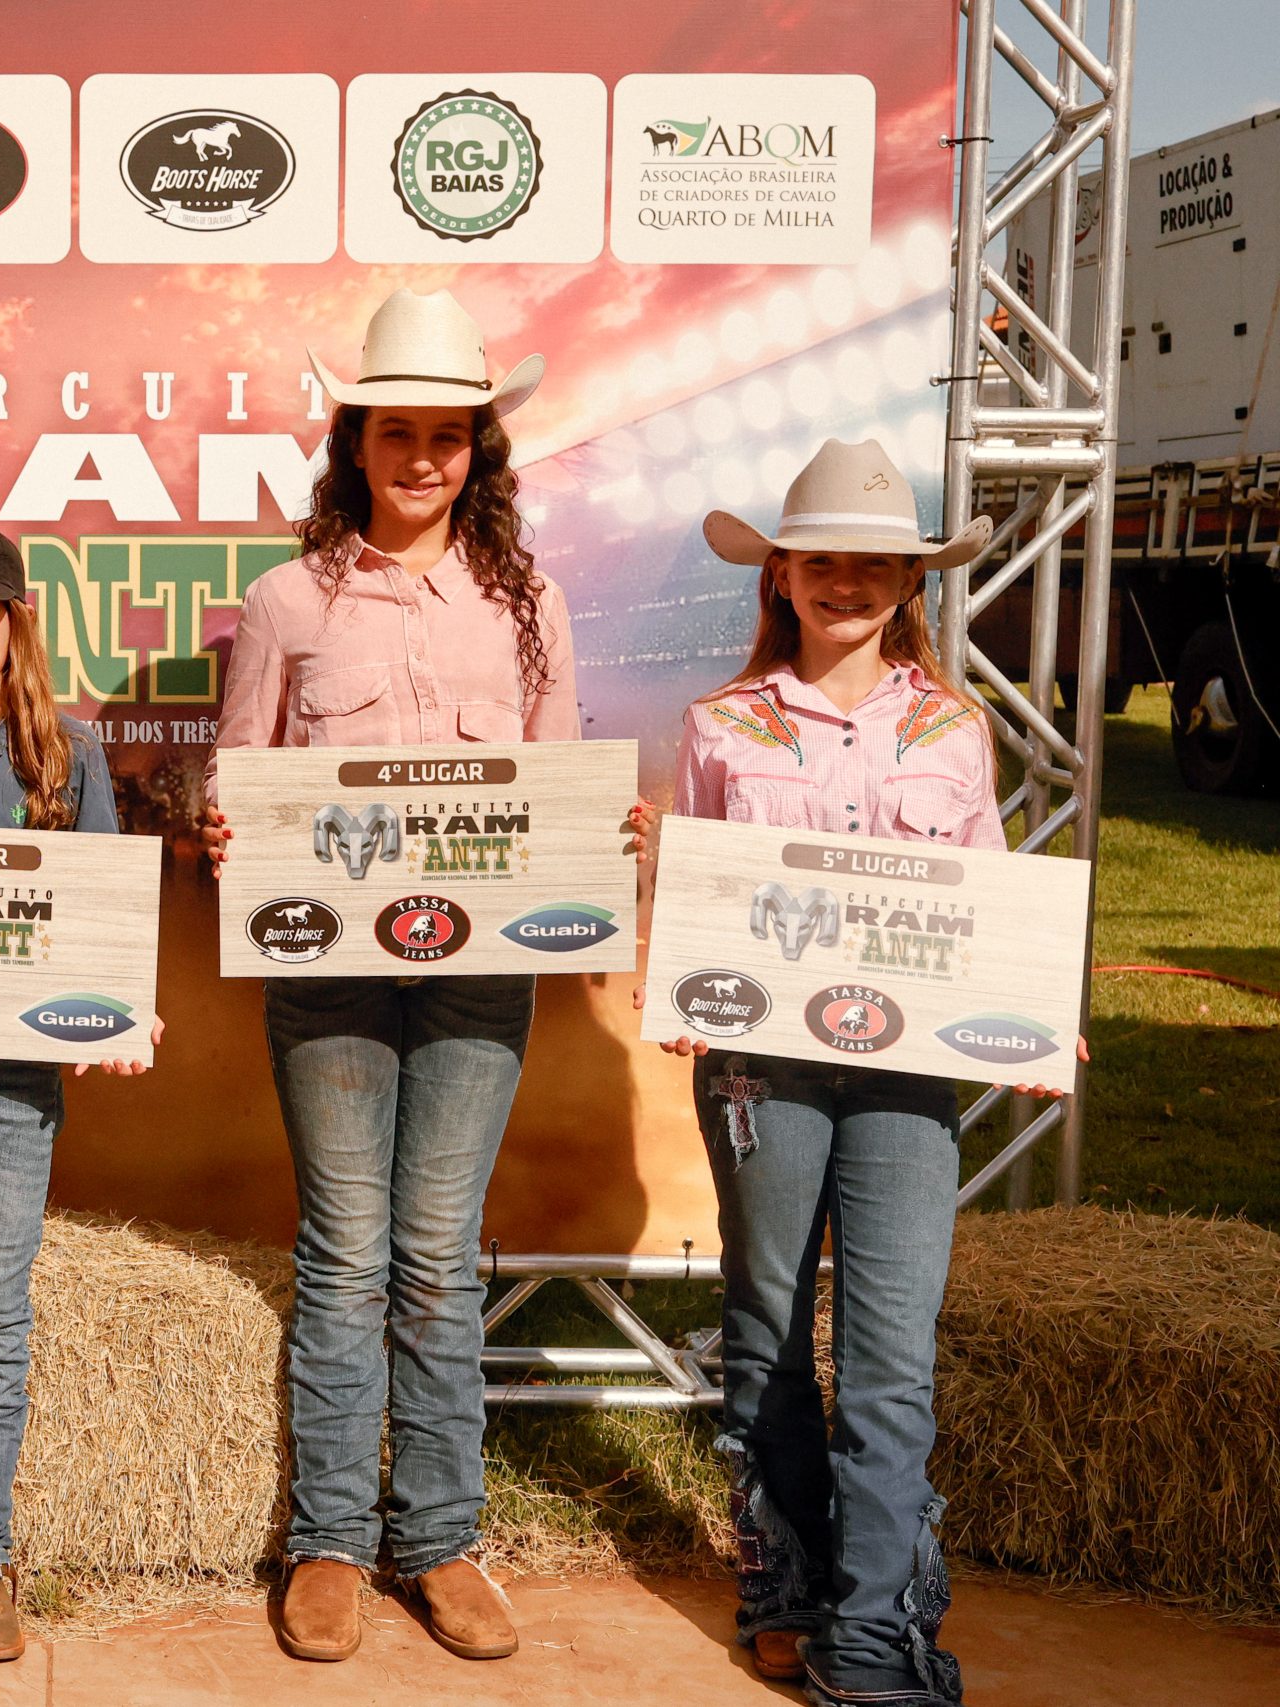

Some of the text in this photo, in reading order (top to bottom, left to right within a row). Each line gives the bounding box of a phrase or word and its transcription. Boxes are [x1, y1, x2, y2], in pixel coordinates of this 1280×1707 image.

[426, 140, 509, 171] RGJ
[701, 122, 838, 167] ABQM
[151, 166, 263, 192] BOOTS HORSE
[431, 174, 504, 192] BAIAS
[640, 168, 836, 185] ASSOCIAÇÃO BRASILEIRA
[1159, 152, 1233, 198] LOCAÇÃO &
[639, 190, 836, 202] DE CRIADORES DE CAVALO
[421, 204, 511, 229] DESDE 1990
[638, 207, 835, 230] QUARTO DE MILHA
[1160, 188, 1233, 234] PRODUÇÃO
[20, 534, 304, 704] NT
[123, 720, 164, 744] DOS
[170, 716, 219, 744] TRÊS
[377, 762, 485, 782] 4º LUGAR
[406, 801, 529, 814] CIRCUITO
[405, 814, 529, 835] RAM
[422, 835, 513, 873] ANTT
[822, 850, 929, 879] 5º LUGAR
[395, 897, 449, 913] TASSA
[847, 892, 975, 917] CIRCUITO
[519, 921, 597, 938] Guabi
[845, 904, 974, 938] RAM
[263, 928, 326, 943] BOOTS HORSE
[402, 948, 444, 960] JEANS
[859, 927, 955, 973] ANTT
[688, 997, 753, 1017] BOOTS HORSE
[828, 987, 884, 1007] TASSA
[37, 1010, 115, 1029] Guabi
[831, 1039, 874, 1051] JEANS
[955, 1028, 1037, 1052] Guabi
